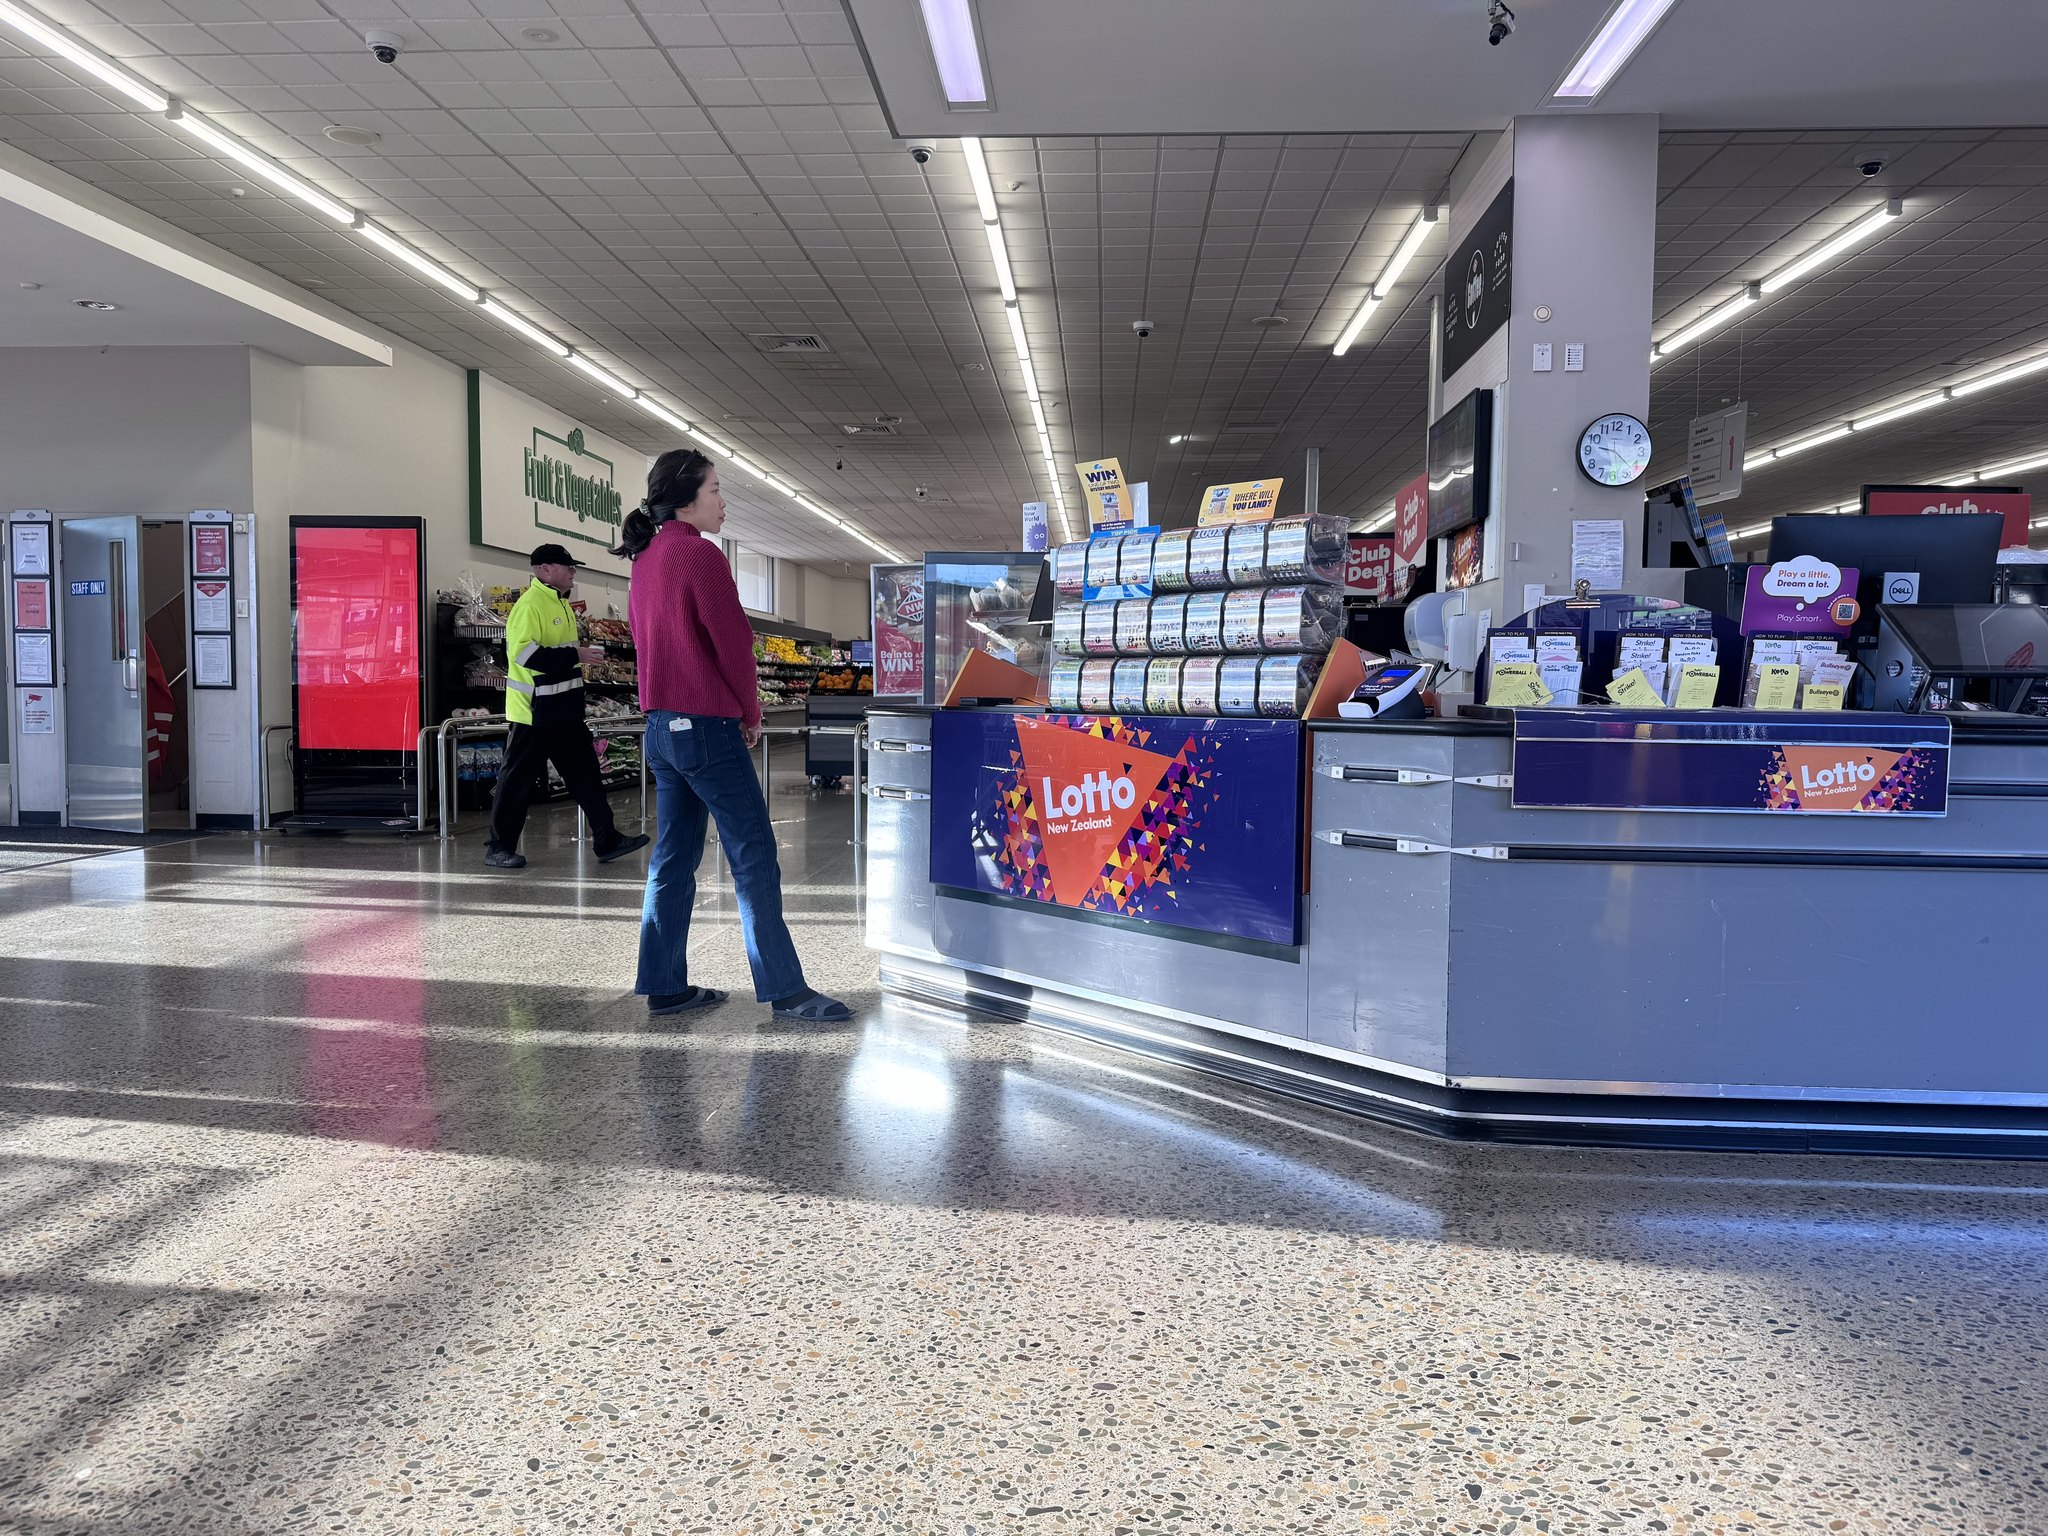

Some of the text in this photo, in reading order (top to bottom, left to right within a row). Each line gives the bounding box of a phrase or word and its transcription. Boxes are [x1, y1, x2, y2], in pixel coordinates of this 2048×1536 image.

[1600, 424, 1609, 434] 11
[1611, 421, 1623, 431] 12
[1626, 425, 1631, 435] 1
[1588, 434, 1601, 444] 10
[1634, 434, 1642, 444] 2
[1584, 445, 1592, 455] 9
[1638, 446, 1644, 457] 3
[1729, 435, 1734, 470] 1
[1588, 459, 1595, 469] 8
[1085, 470, 1118, 482] WIN
[1598, 468, 1605, 478] 7
[1609, 471, 1616, 481] 6
[524, 446, 622, 527] Fruit & Vegetables
[1234, 490, 1274, 502] WHERE WILL
[1232, 499, 1272, 510] YOU LAND?
[1404, 490, 1418, 526] Club
[1403, 514, 1417, 553] Deal
[1348, 544, 1390, 564] Club
[1348, 560, 1390, 582] Deal
[1778, 570, 1797, 579] Play
[1808, 570, 1830, 579] little.
[72, 582, 104, 594] STAFF ONLY
[1777, 614, 1793, 623] Play
[881, 659, 913, 672] WIN
[1617, 679, 1637, 696] Strike!
[1801, 761, 1875, 789] Lotto
[1043, 771, 1135, 819] Lotto
[1824, 784, 1857, 795] Zealand
[1047, 815, 1112, 835] New Zealand
